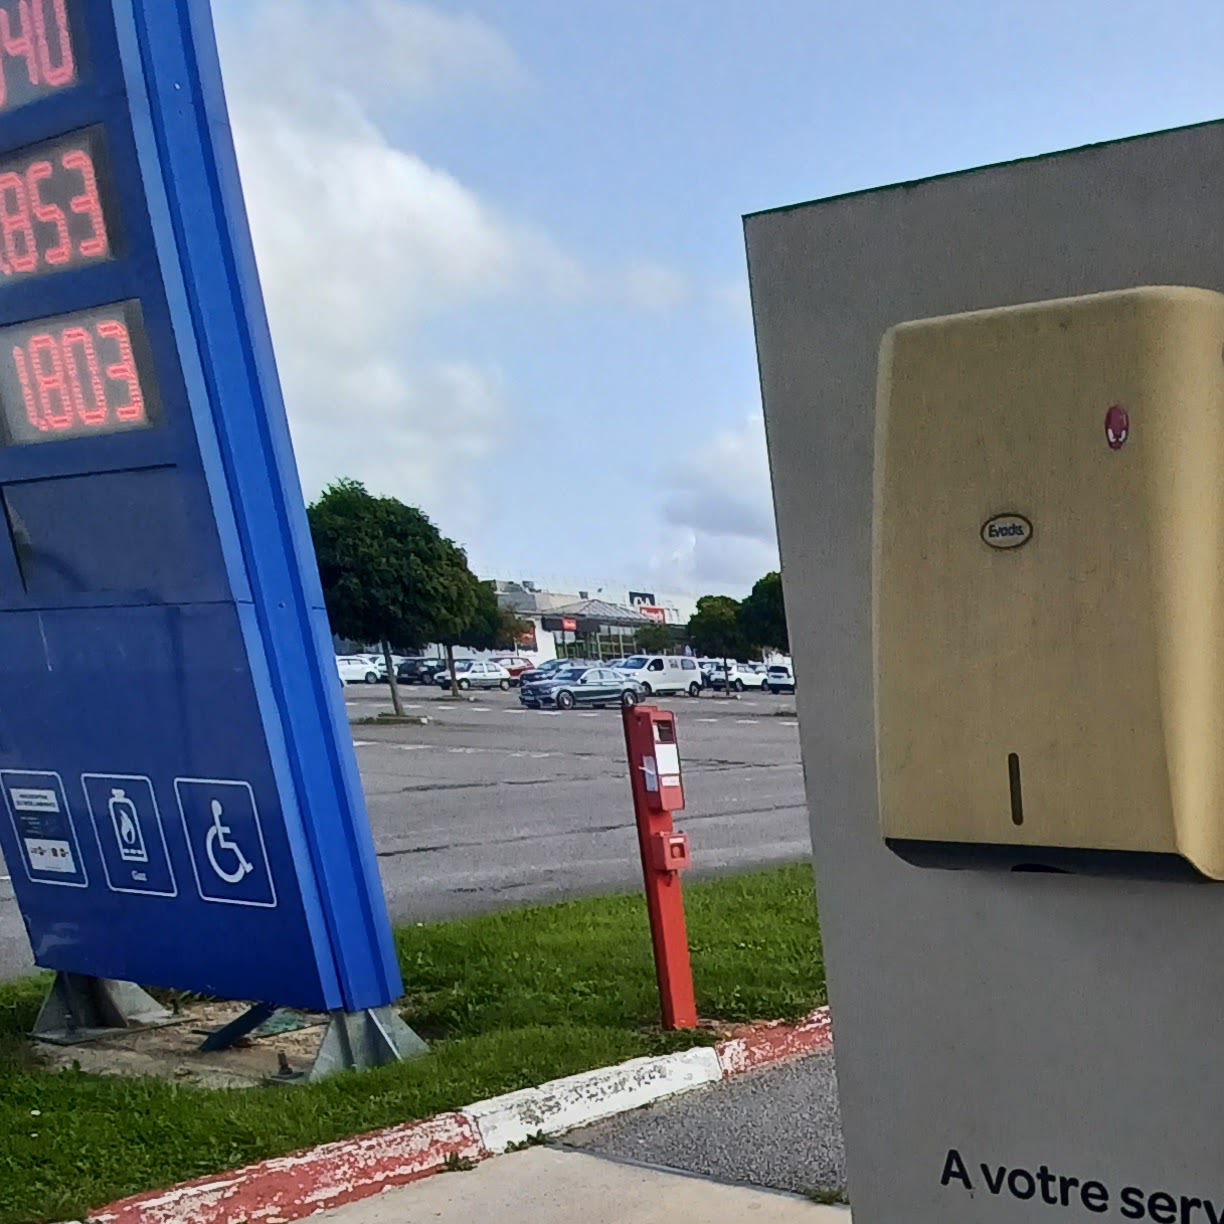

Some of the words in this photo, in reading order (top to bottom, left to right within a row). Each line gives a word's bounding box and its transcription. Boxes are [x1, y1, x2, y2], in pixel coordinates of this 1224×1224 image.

[0, 0, 74, 106] 40
[941, 1148, 973, 1190] A
[980, 1163, 1109, 1214] votre
